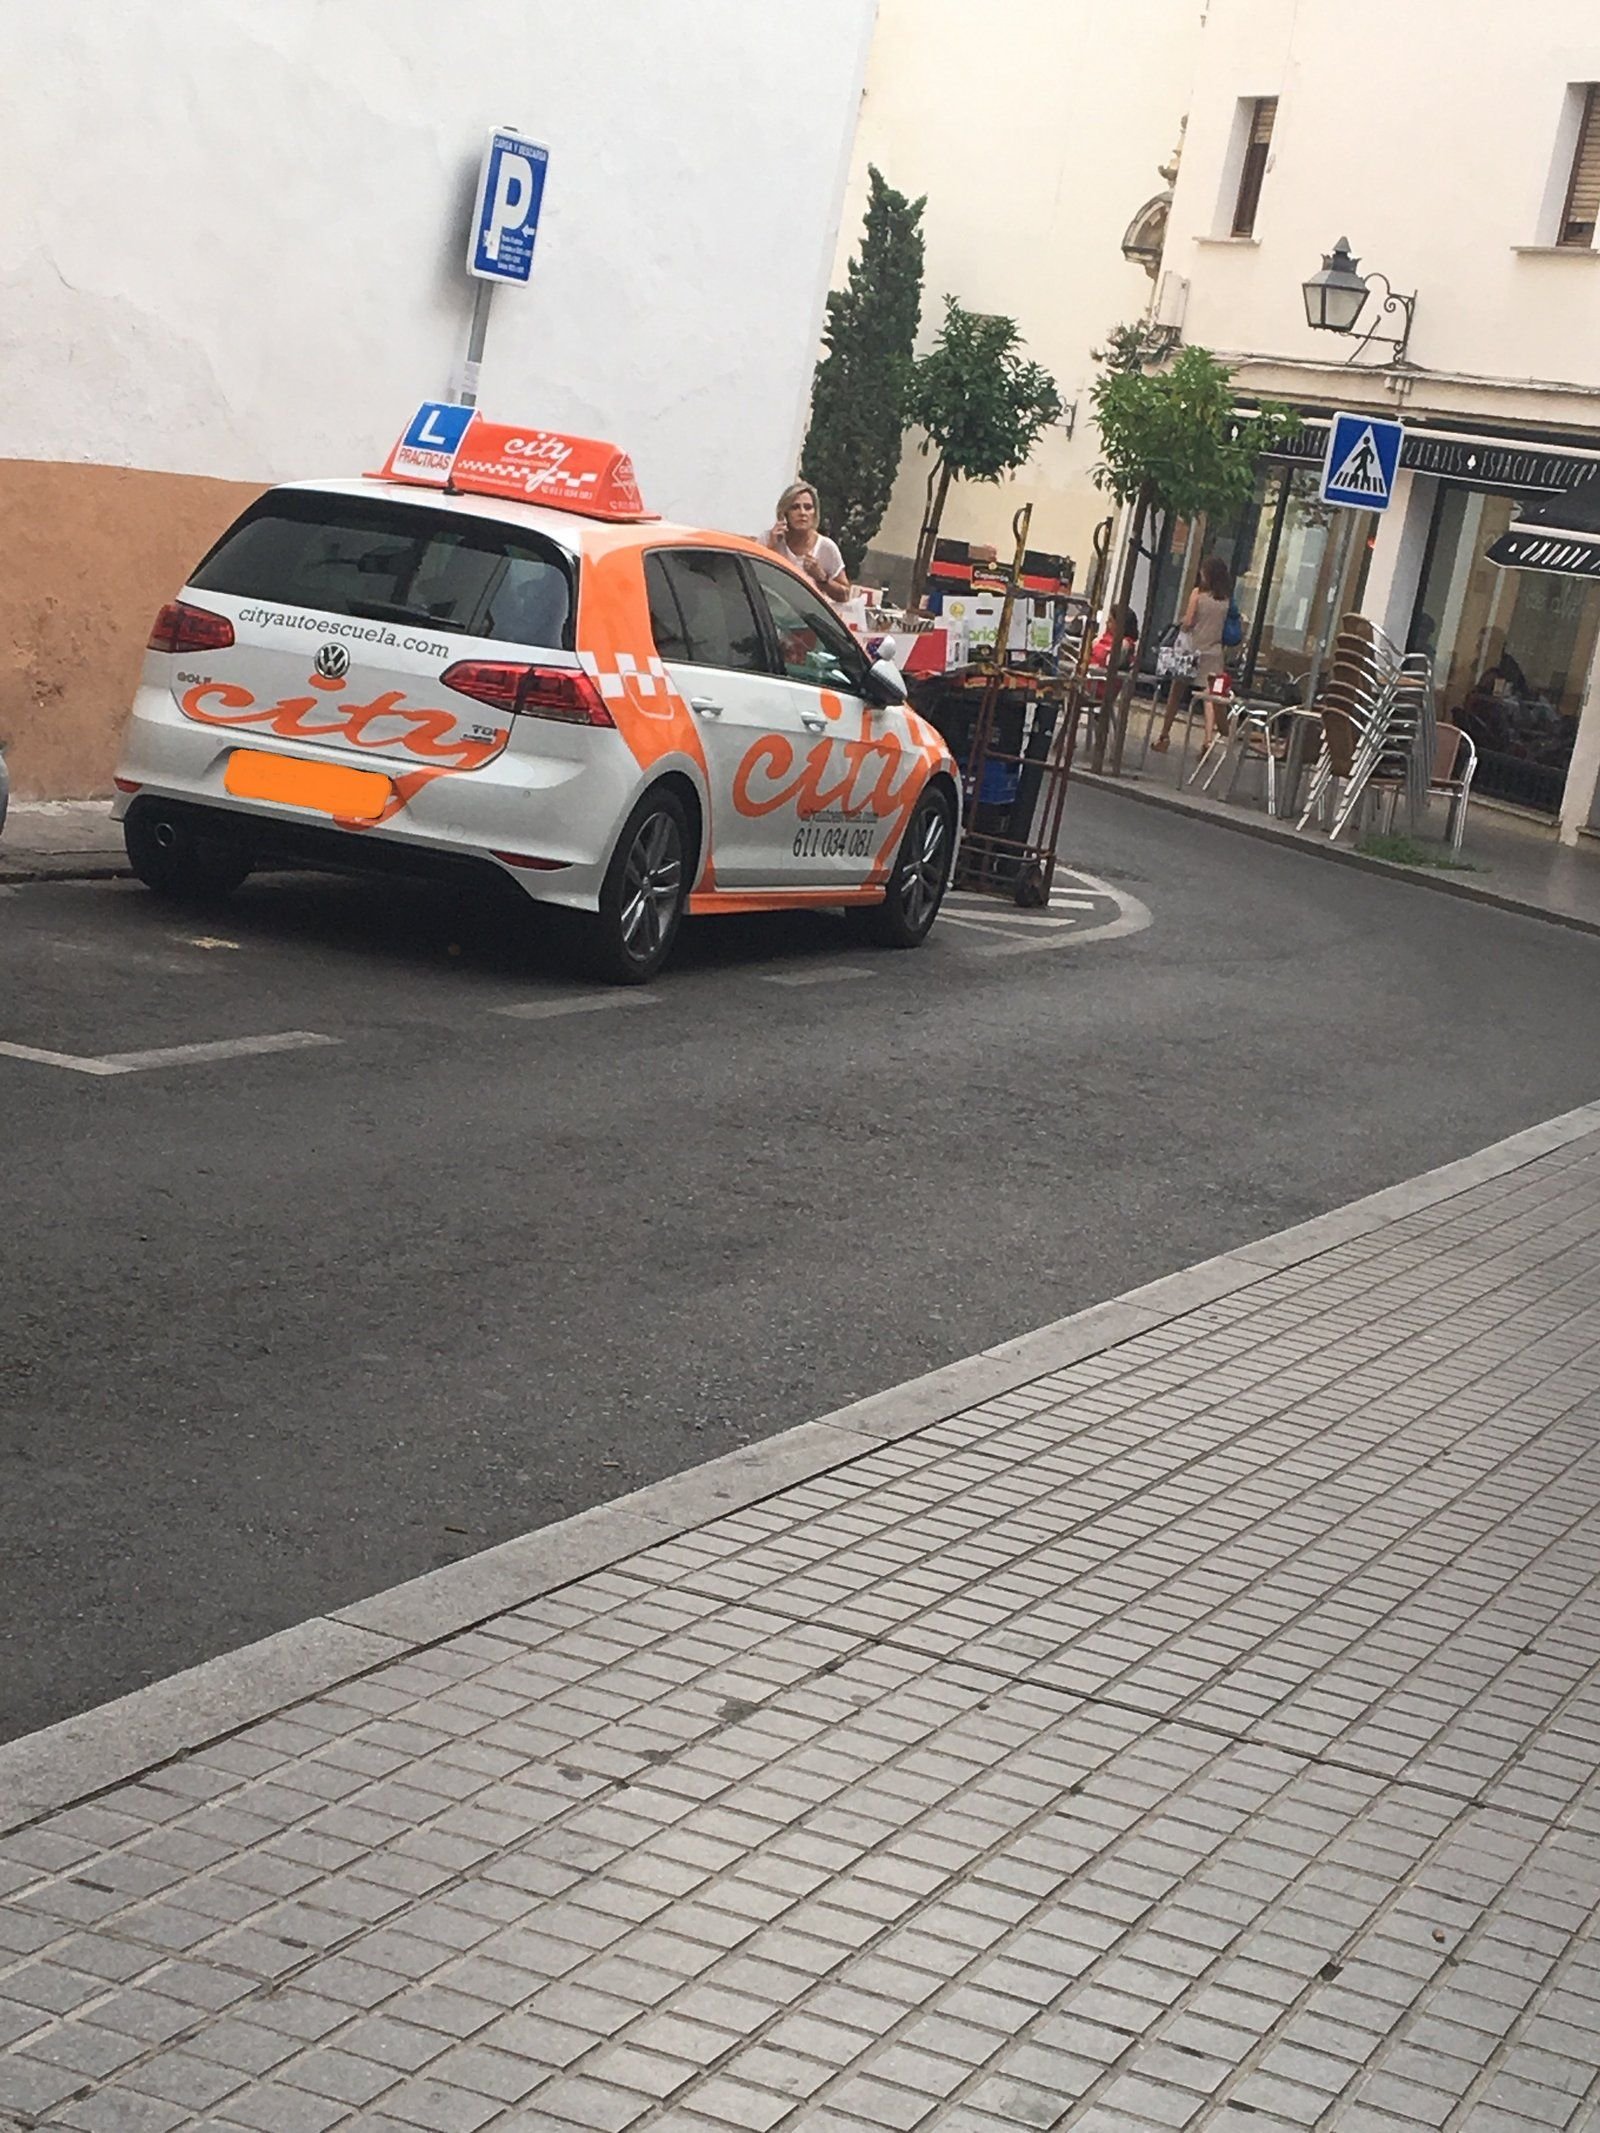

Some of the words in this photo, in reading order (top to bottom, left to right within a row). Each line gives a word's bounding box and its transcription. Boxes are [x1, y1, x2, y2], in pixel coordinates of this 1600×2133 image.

[486, 151, 533, 260] P
[418, 410, 446, 445] L
[504, 433, 573, 493] city
[239, 606, 450, 659] cityautoescuela.com
[181, 674, 509, 831] city
[732, 688, 930, 890] city
[793, 827, 820, 857] 611
[821, 827, 849, 857] 034
[848, 828, 874, 857] 081
